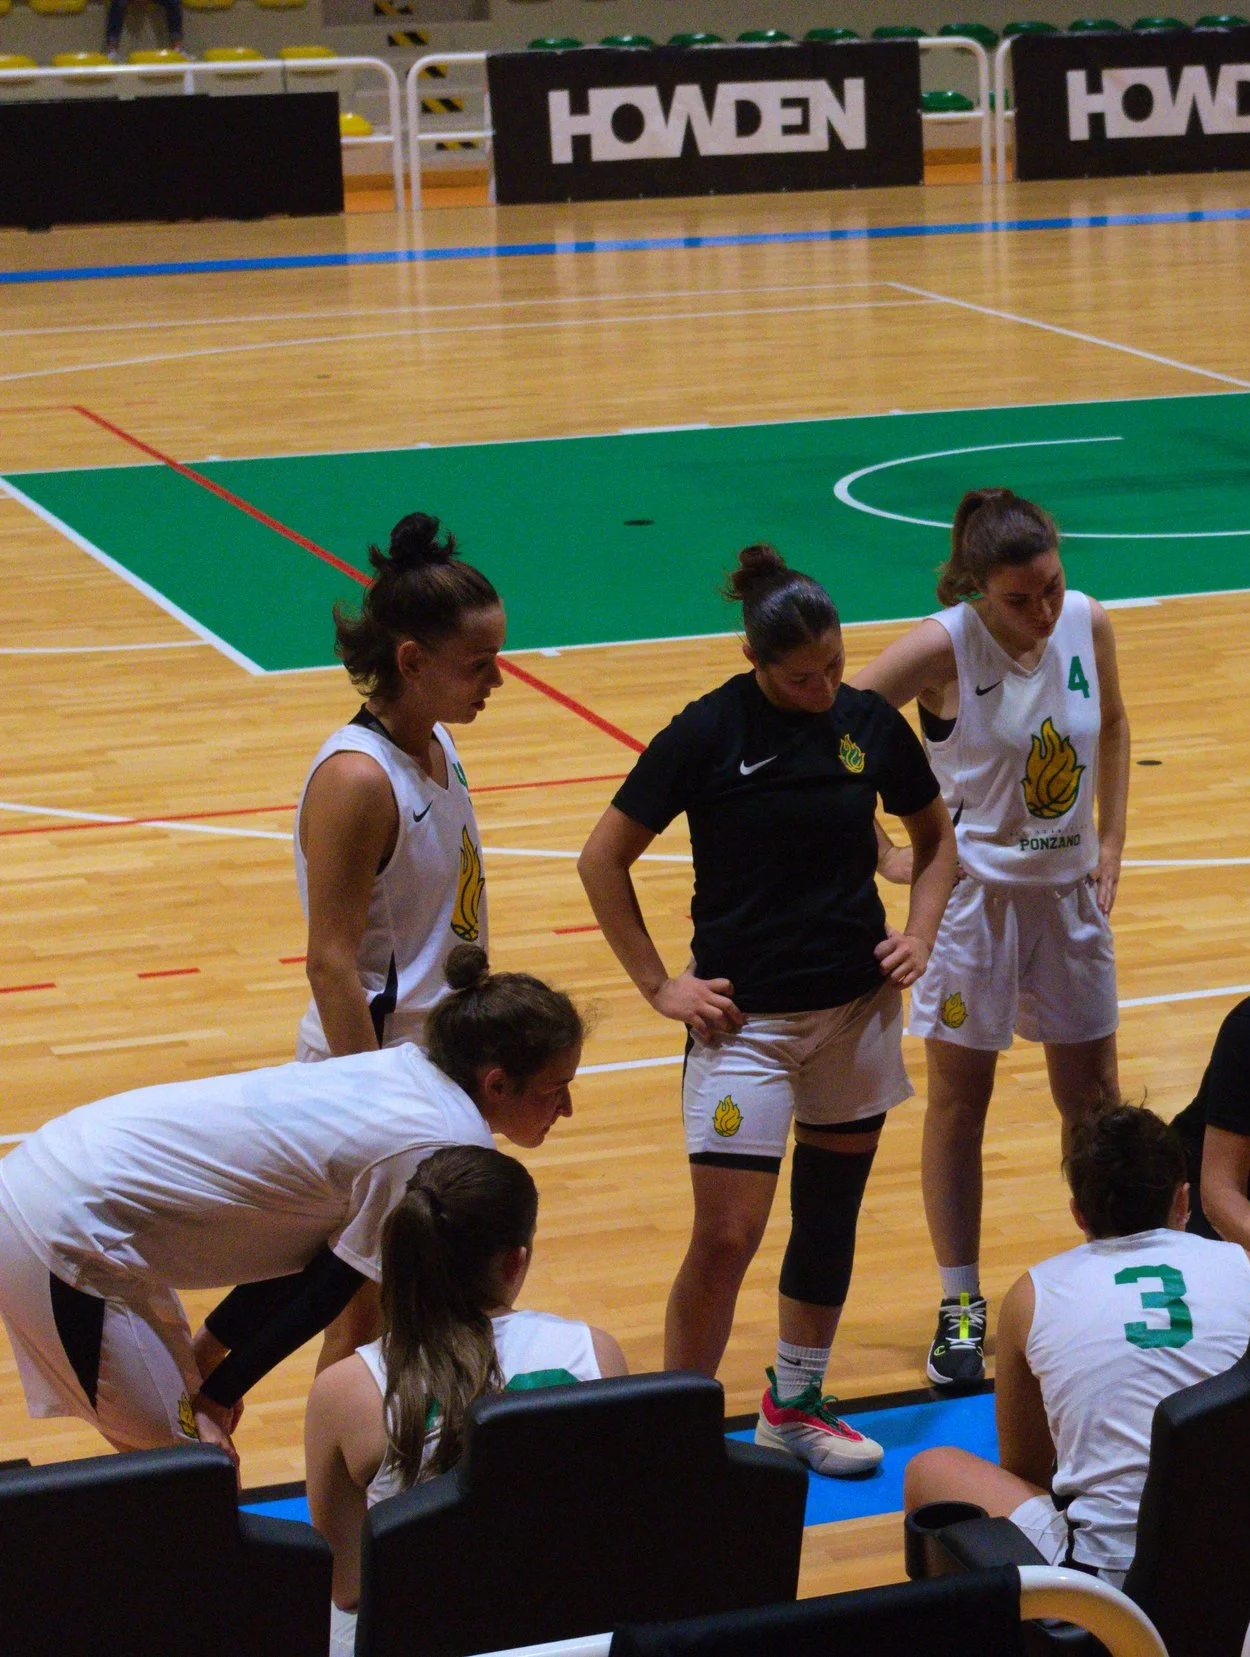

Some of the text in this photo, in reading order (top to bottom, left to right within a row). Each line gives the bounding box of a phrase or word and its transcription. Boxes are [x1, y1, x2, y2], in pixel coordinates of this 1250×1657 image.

[548, 78, 866, 164] HOWDEN
[1067, 655, 1090, 699] 4
[1020, 834, 1081, 851] PONZANO
[1114, 1263, 1194, 1349] 3
